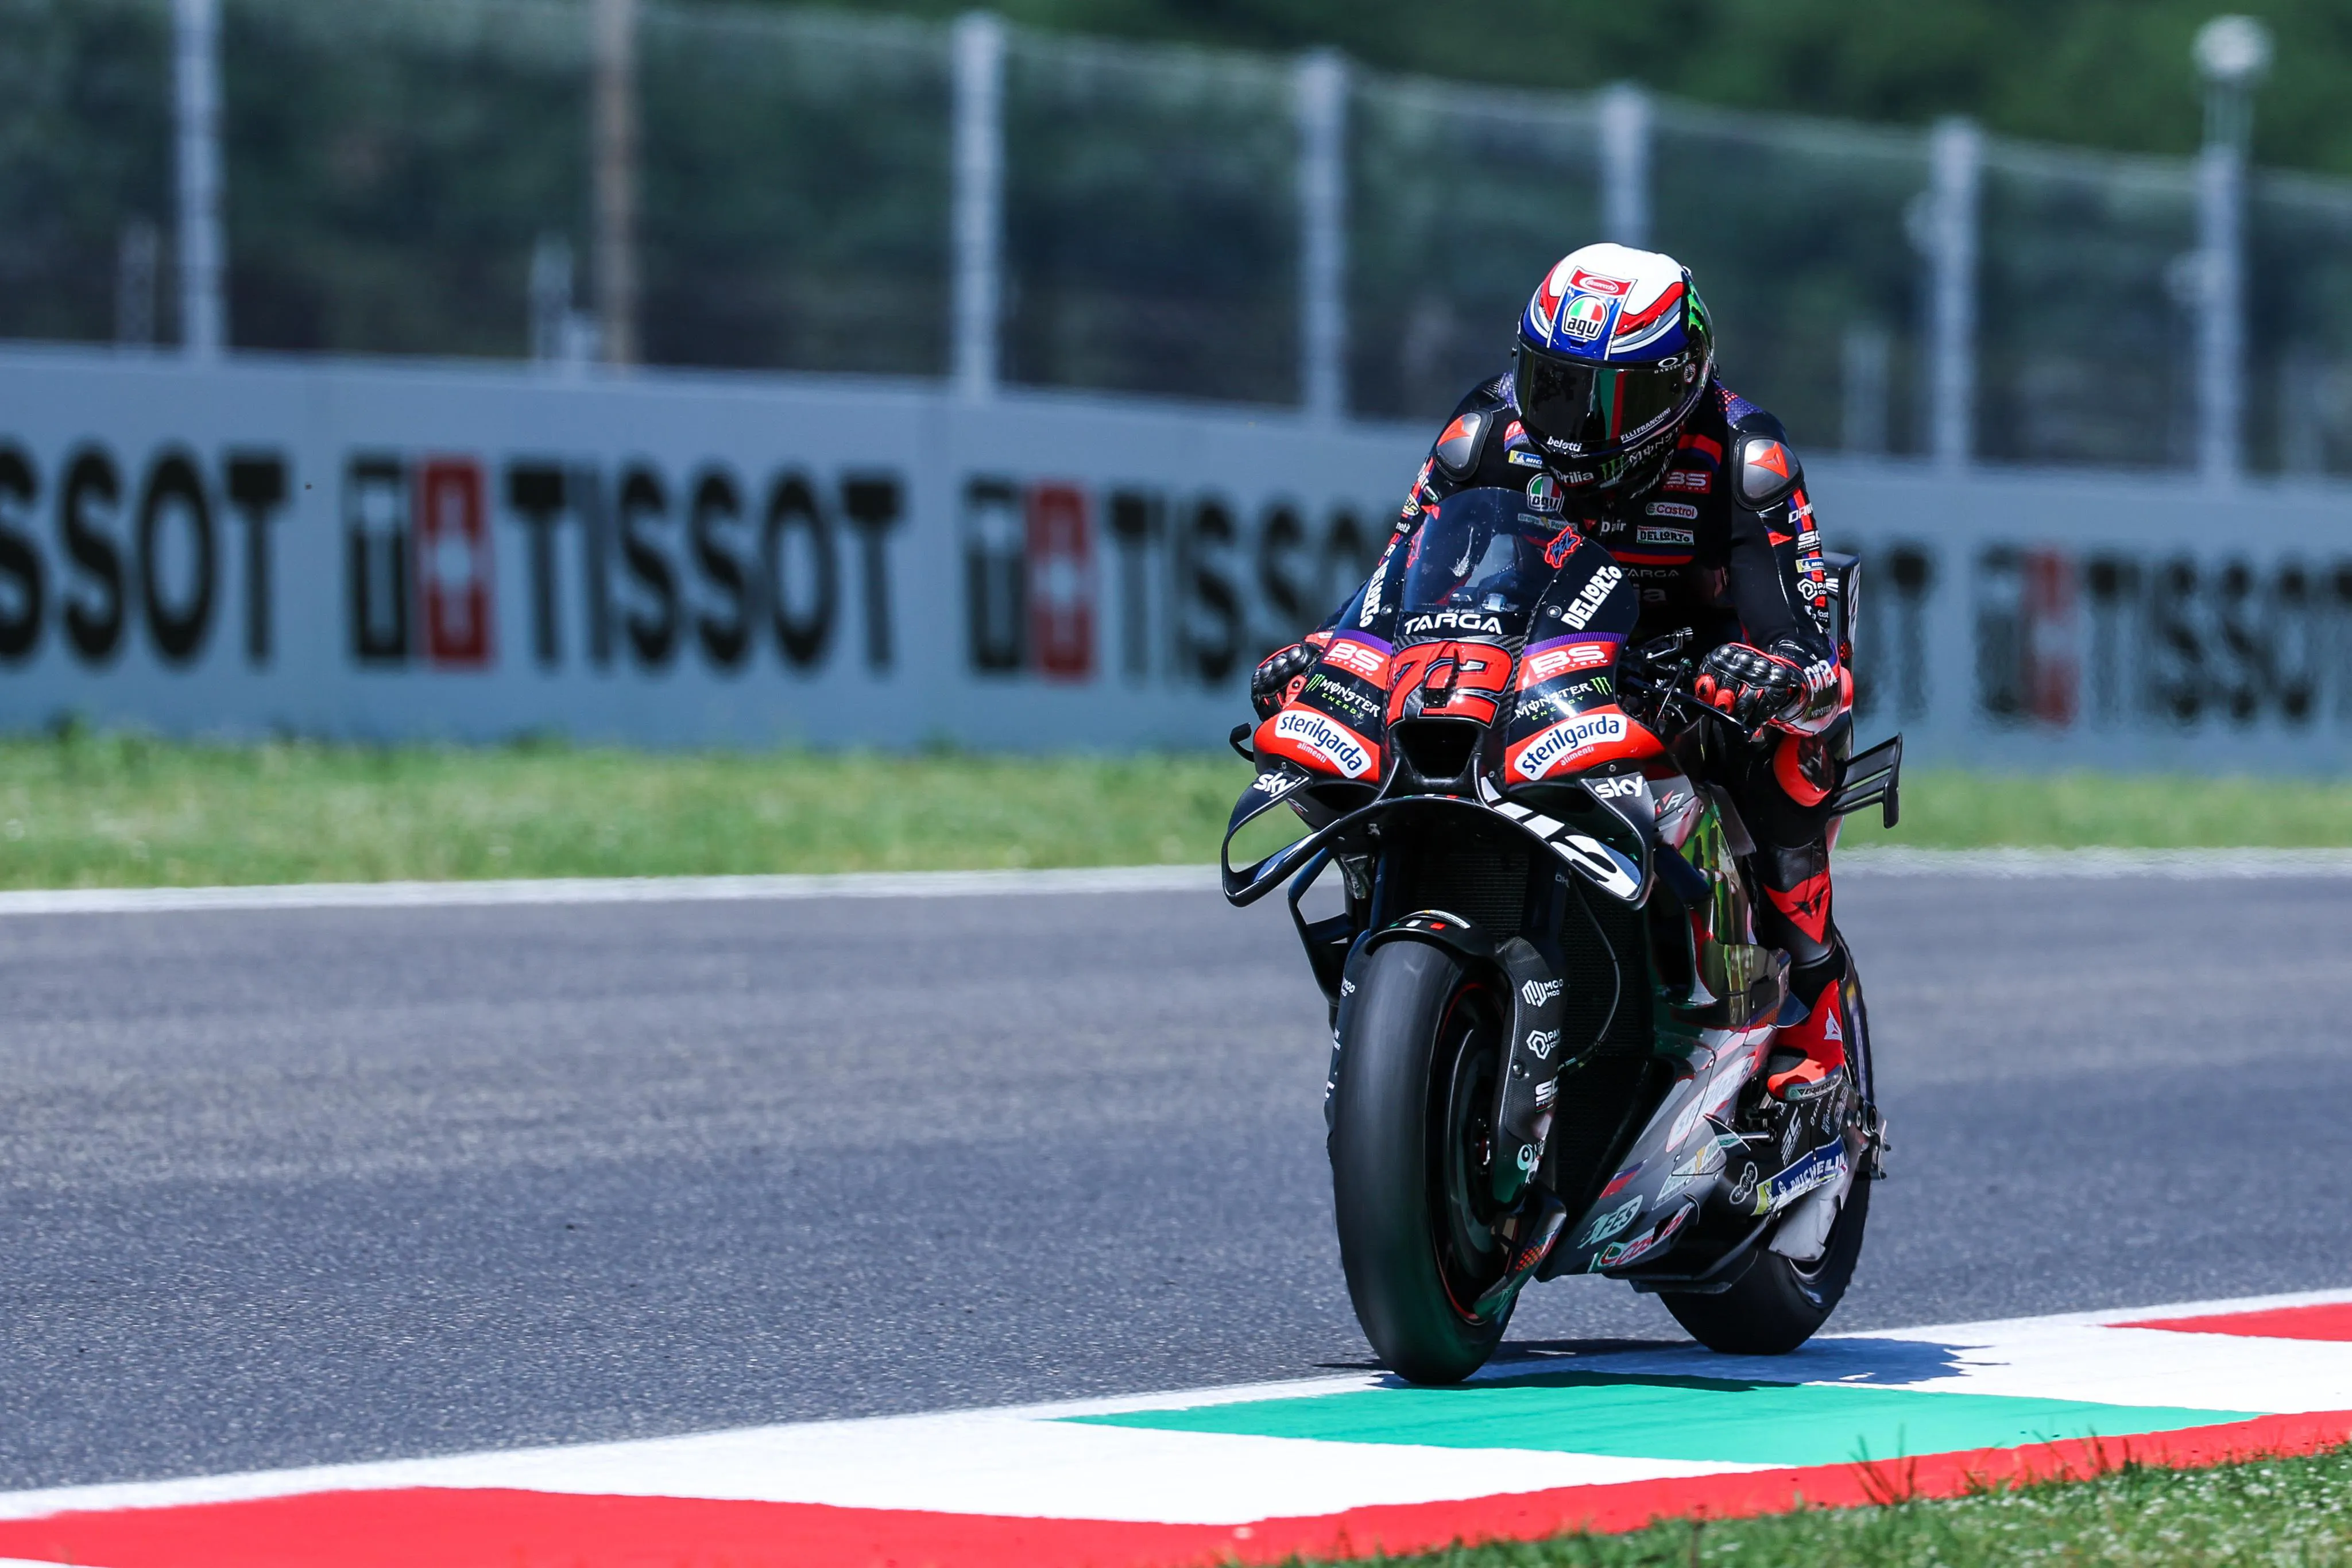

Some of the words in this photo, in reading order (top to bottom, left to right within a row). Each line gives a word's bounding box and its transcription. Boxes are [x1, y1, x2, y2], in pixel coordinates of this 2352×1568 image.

[1566, 318, 1599, 336] agv
[1637, 407, 1671, 434] FRANCHINI
[1546, 436, 1583, 452] belotti
[1656, 504, 1695, 517] Castrol
[503, 461, 906, 679] TISSOT
[1106, 481, 1404, 691] TISSO
[1561, 566, 1623, 630] DELLORTO
[1405, 613, 1503, 635] TARGA
[1324, 656, 1373, 676] BATTERY
[1327, 642, 1384, 672] BS
[1529, 645, 1606, 675] BS
[1535, 659, 1608, 679] BATTERY
[1387, 640, 1515, 729] 72
[1320, 679, 1381, 718] MONSTER
[1321, 692, 1364, 718] ENERGY
[1514, 682, 1593, 719] MONSTER
[1280, 714, 1363, 771] sterilgarda
[1296, 741, 1327, 763] alimenti
[1521, 715, 1620, 774] sterilgarda
[1560, 744, 1595, 766] alimenti
[1253, 772, 1297, 797] sky
[1595, 776, 1643, 799] sky
[1790, 1151, 1845, 1191] MICHELIN
